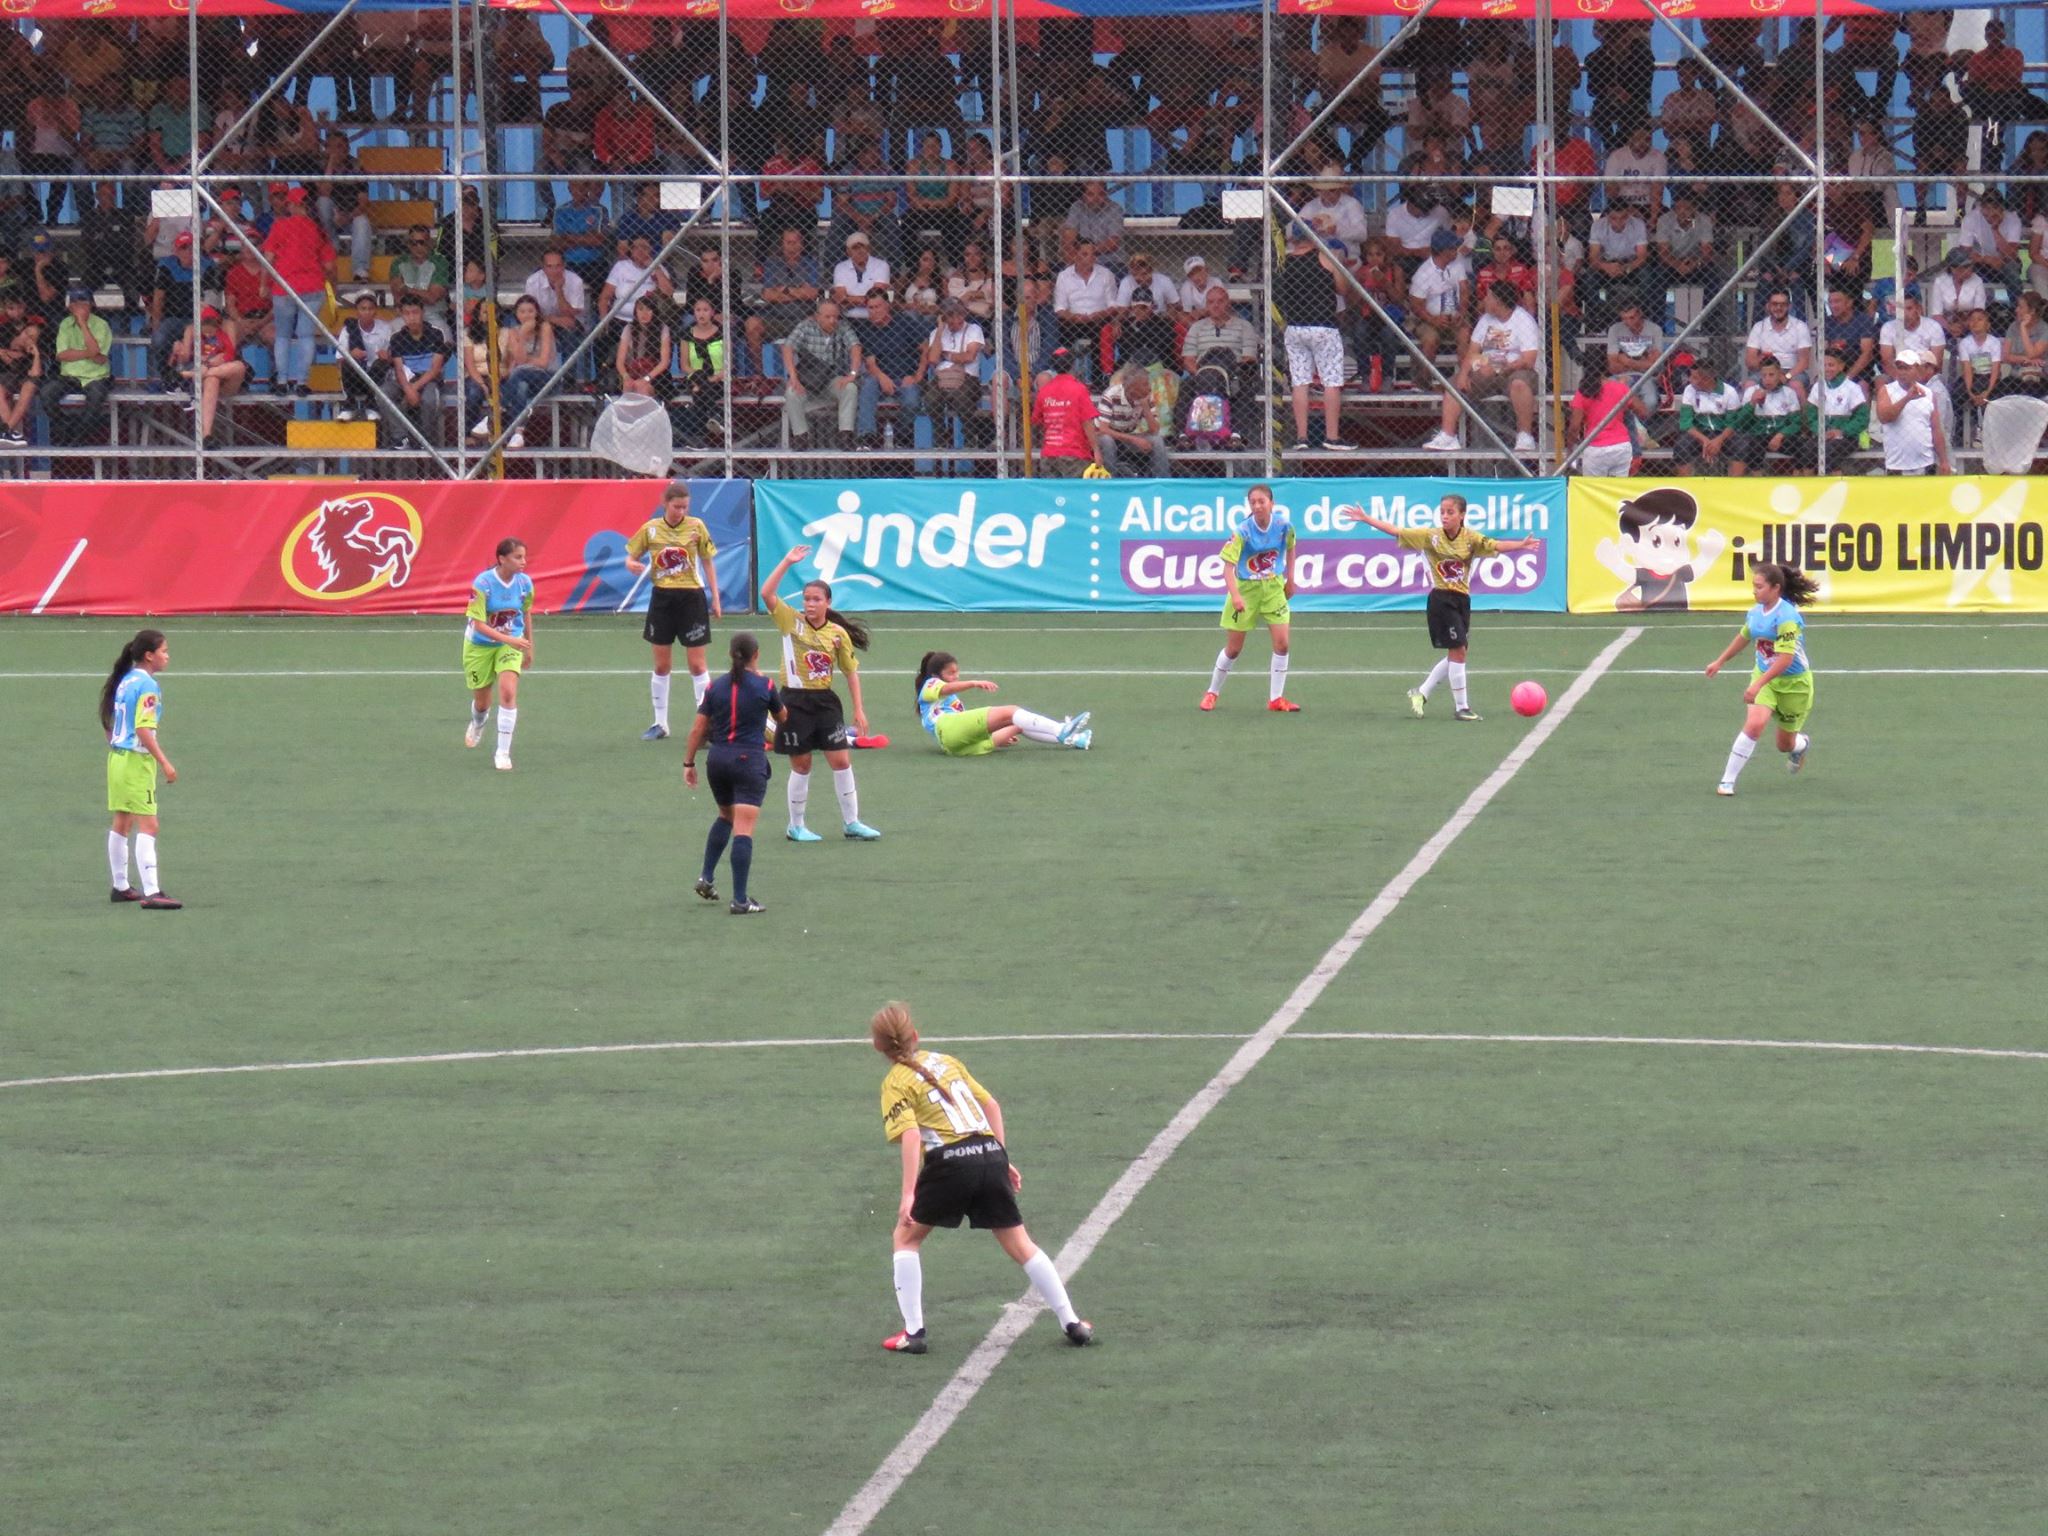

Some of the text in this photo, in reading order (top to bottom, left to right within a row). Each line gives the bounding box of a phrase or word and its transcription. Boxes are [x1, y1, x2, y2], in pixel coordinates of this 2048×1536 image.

[1371, 494, 1549, 531] Meellín
[802, 490, 1066, 583] inder
[1732, 522, 2044, 581] ¡JUEGO LIMPIO
[1449, 627, 1458, 640] 5
[472, 671, 479, 683] 5
[783, 732, 799, 746] 11
[927, 1080, 992, 1135] 10
[943, 1144, 984, 1160] PONY
